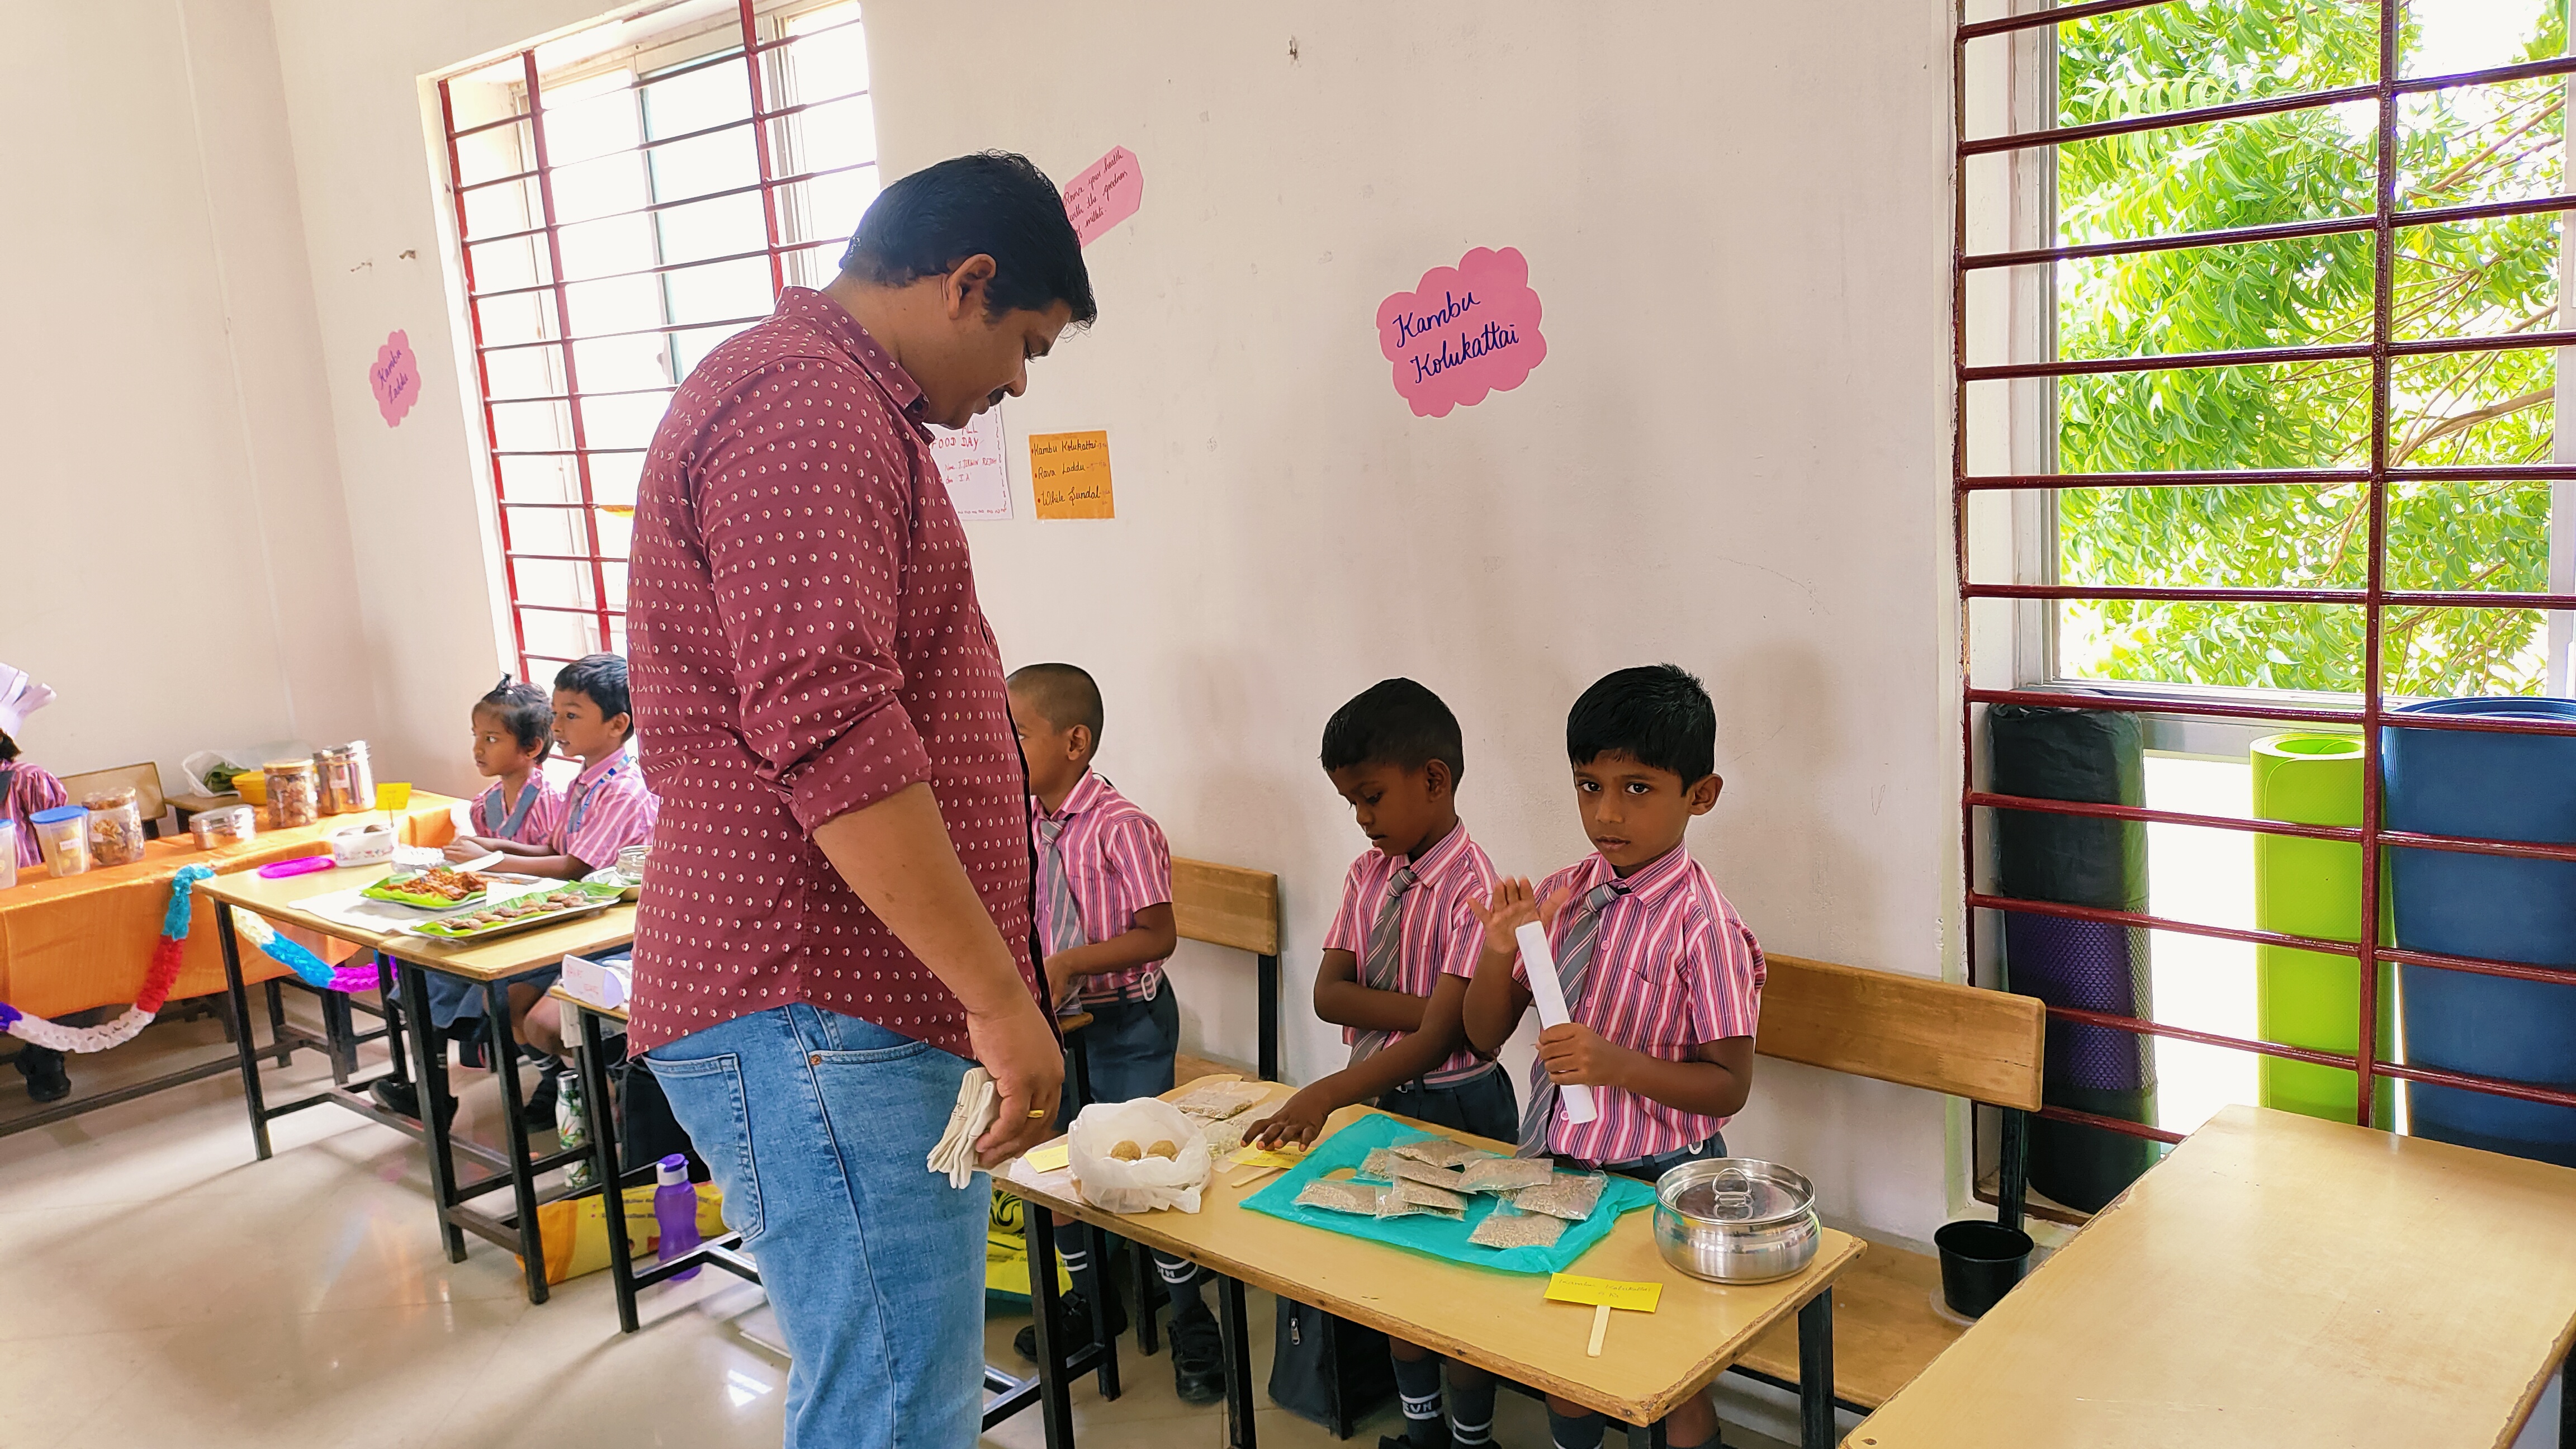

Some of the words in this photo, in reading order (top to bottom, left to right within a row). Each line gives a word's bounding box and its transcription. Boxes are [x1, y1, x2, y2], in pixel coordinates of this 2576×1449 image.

[1088, 171, 1102, 191] your
[1104, 149, 1123, 173] health
[1069, 203, 1084, 222] with
[1087, 192, 1098, 209] the
[1392, 291, 1481, 348] Kambu
[1410, 321, 1519, 383] Kolukattai
[961, 437, 978, 452] DAY
[1034, 442, 1057, 456] Kambu
[1062, 439, 1097, 452] Kolukattai
[1038, 467, 1056, 479] Rava
[1062, 461, 1086, 475] Laddu
